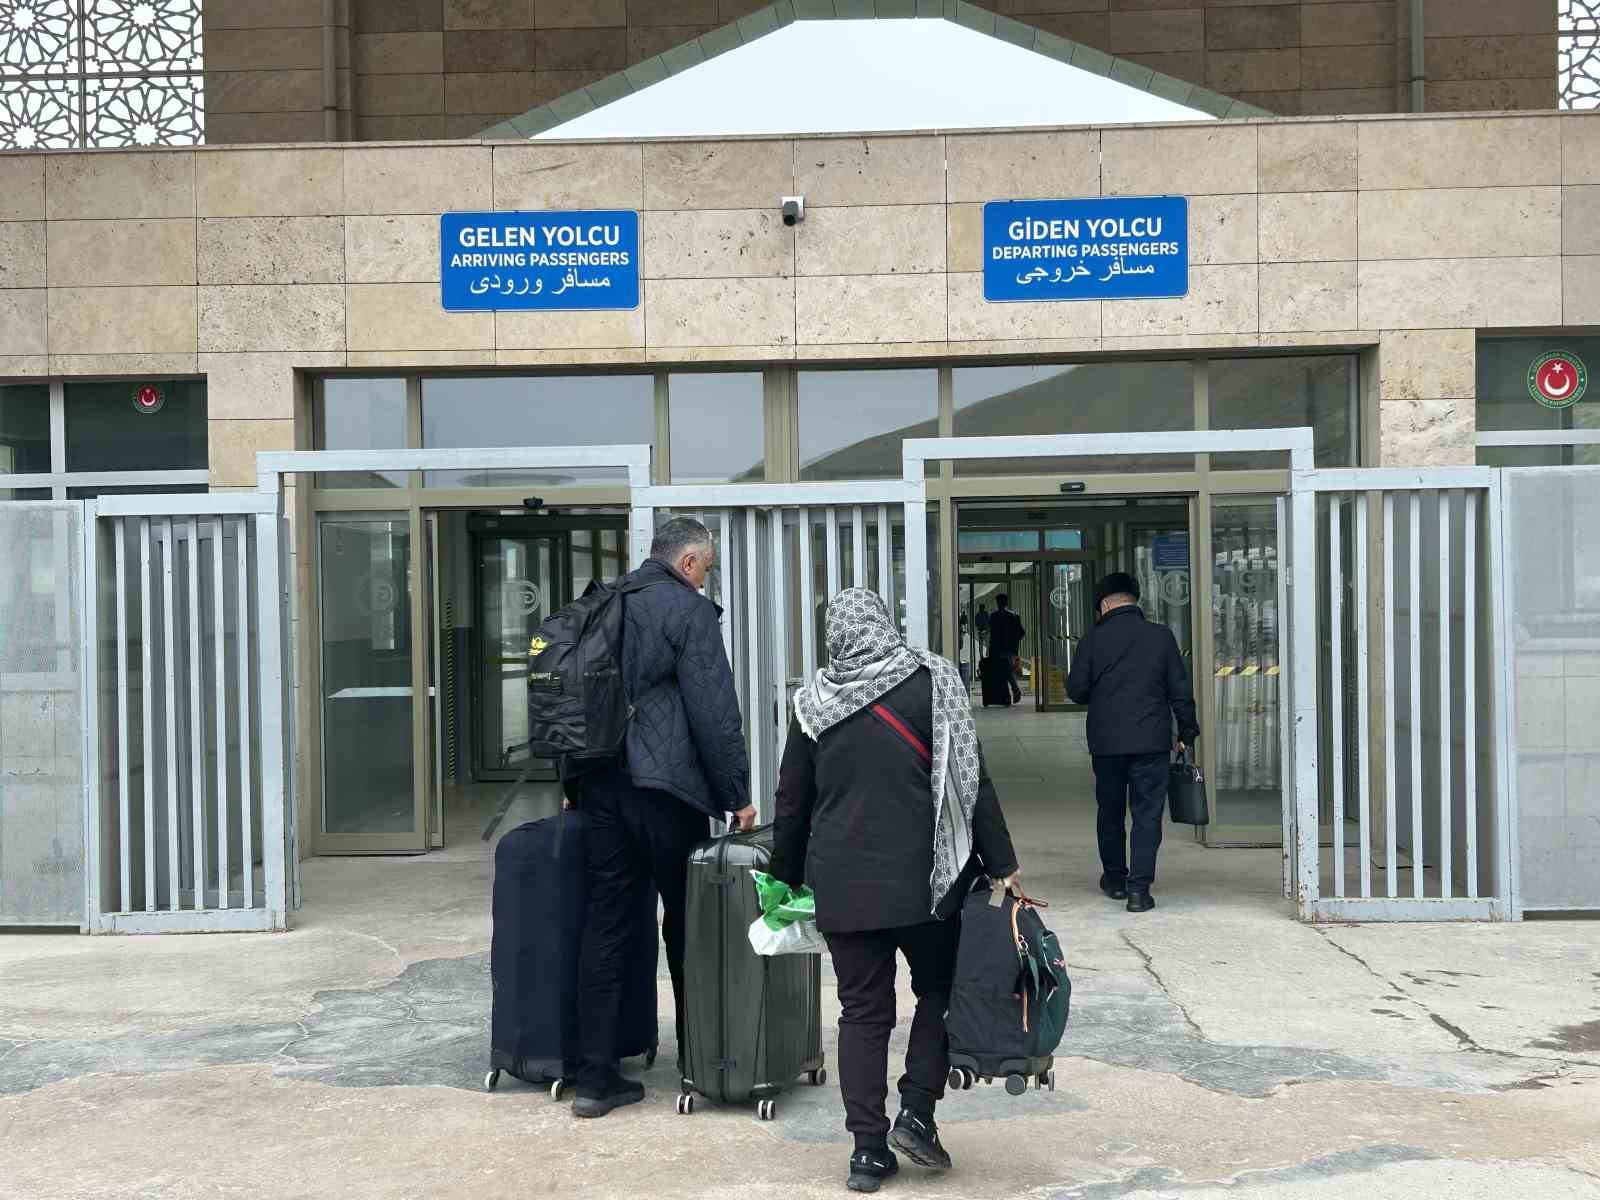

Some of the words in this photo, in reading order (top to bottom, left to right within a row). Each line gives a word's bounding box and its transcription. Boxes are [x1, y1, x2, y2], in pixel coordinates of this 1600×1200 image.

[459, 226, 536, 247] GELEN
[541, 225, 620, 246] YOLCU
[1086, 217, 1162, 238] YOLCU
[450, 254, 526, 267] ARRIVING
[529, 252, 629, 266] PASSENGERS
[992, 245, 1078, 260] DEPARTING
[1081, 242, 1179, 257] PASSENGERS
[1099, 257, 1155, 281] مسافر
[552, 268, 611, 295] مسافر
